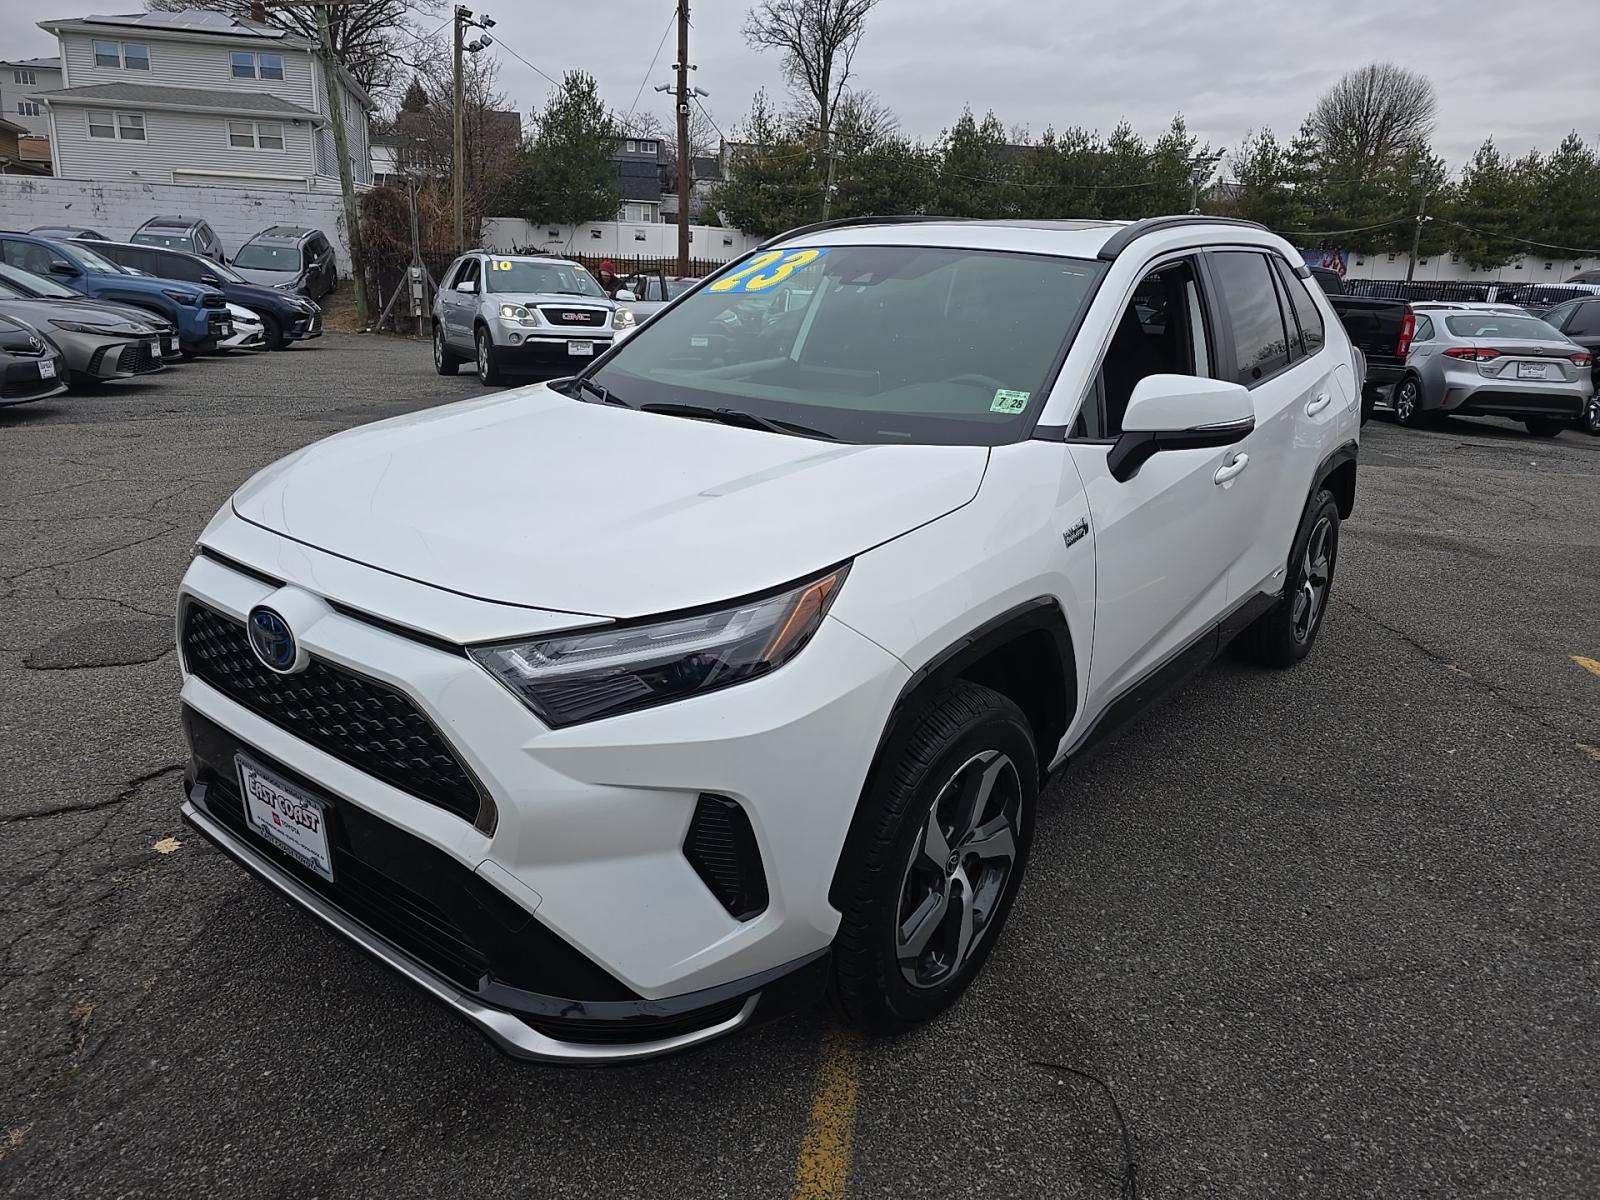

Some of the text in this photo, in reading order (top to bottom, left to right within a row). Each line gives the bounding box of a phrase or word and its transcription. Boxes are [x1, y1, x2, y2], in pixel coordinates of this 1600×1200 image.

[492, 261, 512, 271] 10
[710, 250, 820, 292] 23
[562, 313, 590, 321] GMC
[998, 397, 1007, 407] 7
[248, 778, 277, 809] EAST
[276, 794, 319, 833] COAST
